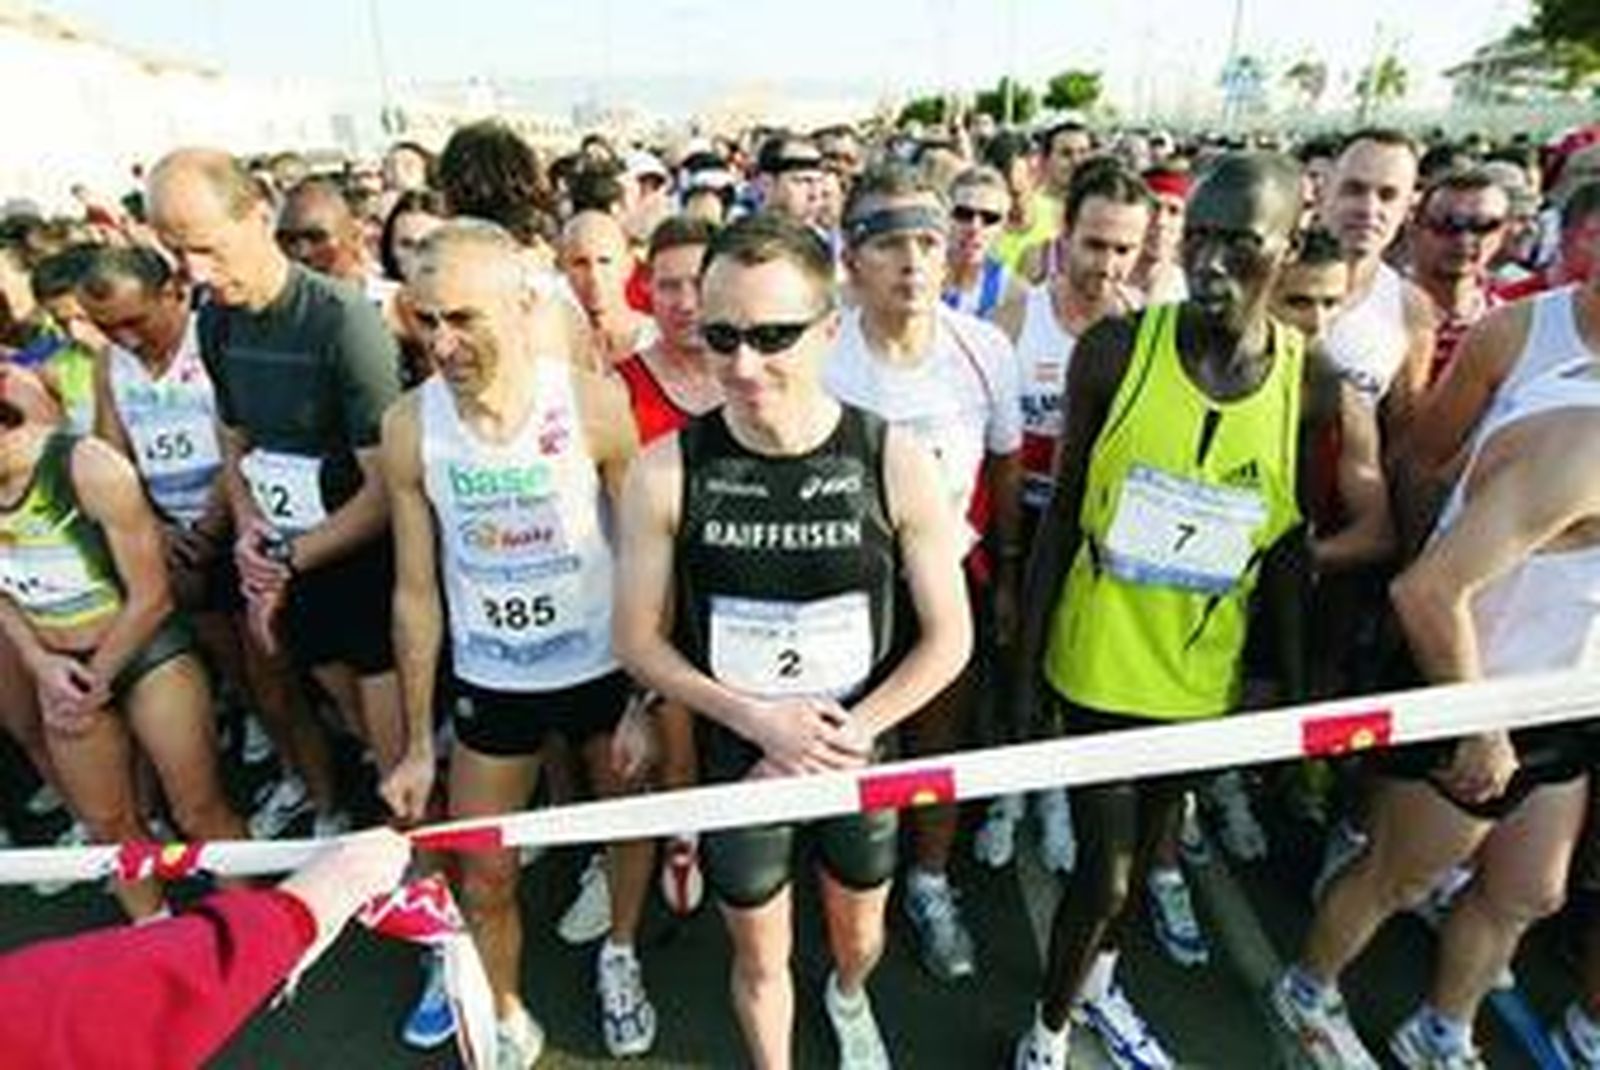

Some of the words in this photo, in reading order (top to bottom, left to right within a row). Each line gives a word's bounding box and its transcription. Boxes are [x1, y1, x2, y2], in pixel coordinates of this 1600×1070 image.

[703, 520, 862, 548] RAIFFEISEN
[1174, 523, 1198, 552] 7
[777, 649, 802, 677] 2
